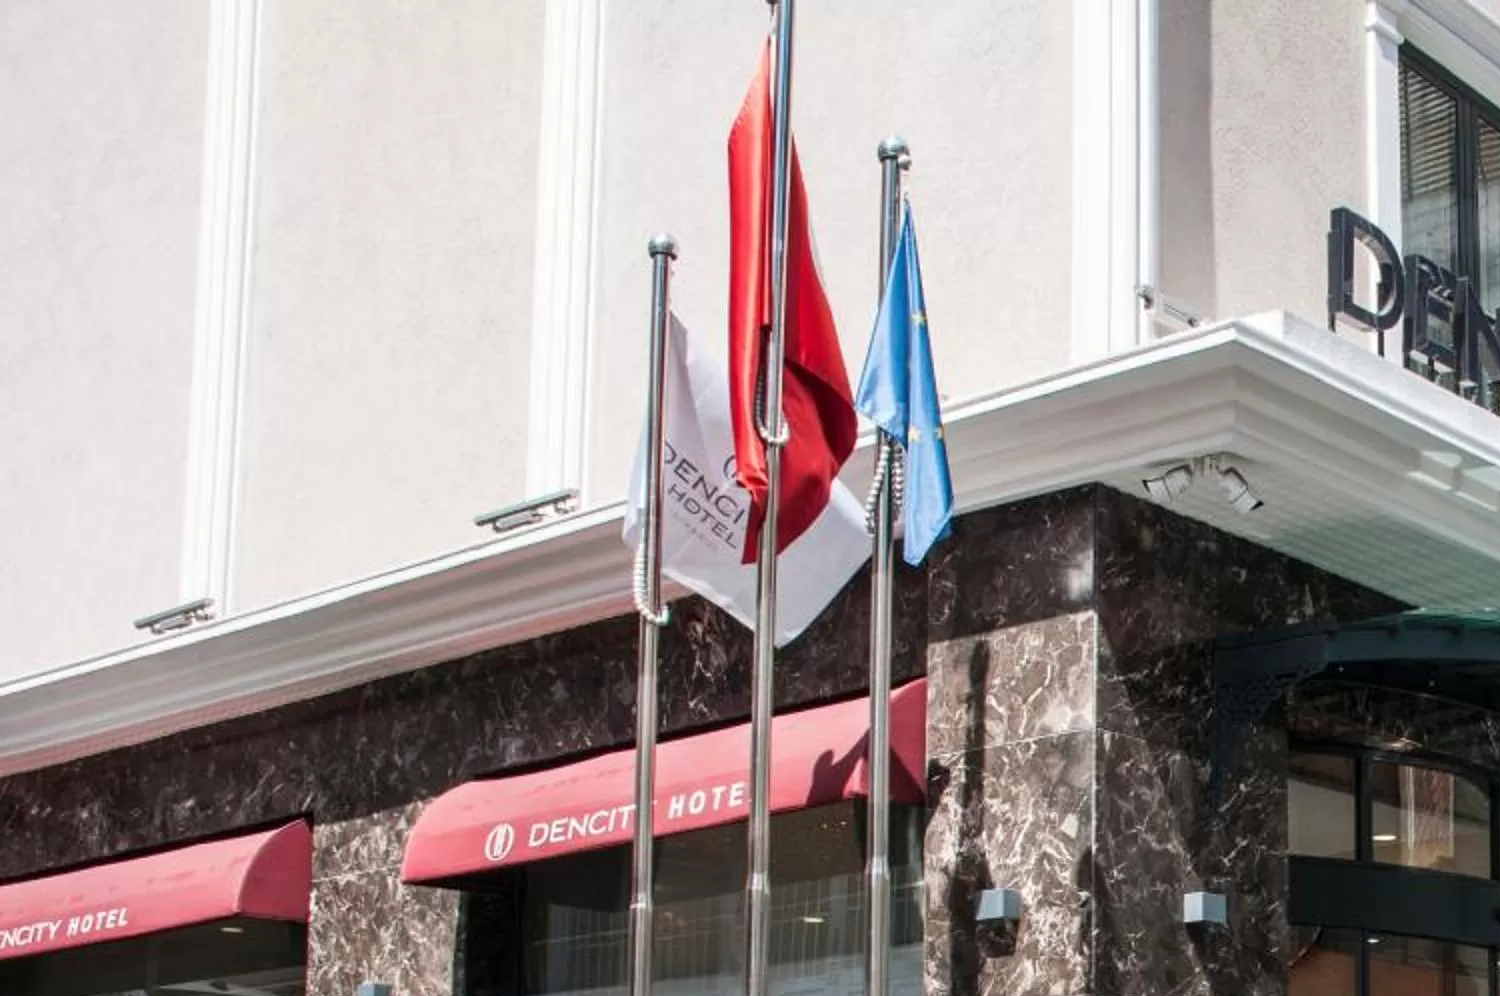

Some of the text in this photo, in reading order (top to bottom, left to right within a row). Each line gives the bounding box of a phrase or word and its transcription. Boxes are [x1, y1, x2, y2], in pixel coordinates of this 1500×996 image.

[664, 440, 745, 525] DENCI
[669, 484, 737, 550] HOTEL
[528, 781, 752, 847] DENCIT HOTE
[0, 907, 128, 949] NCITY HOTEL
